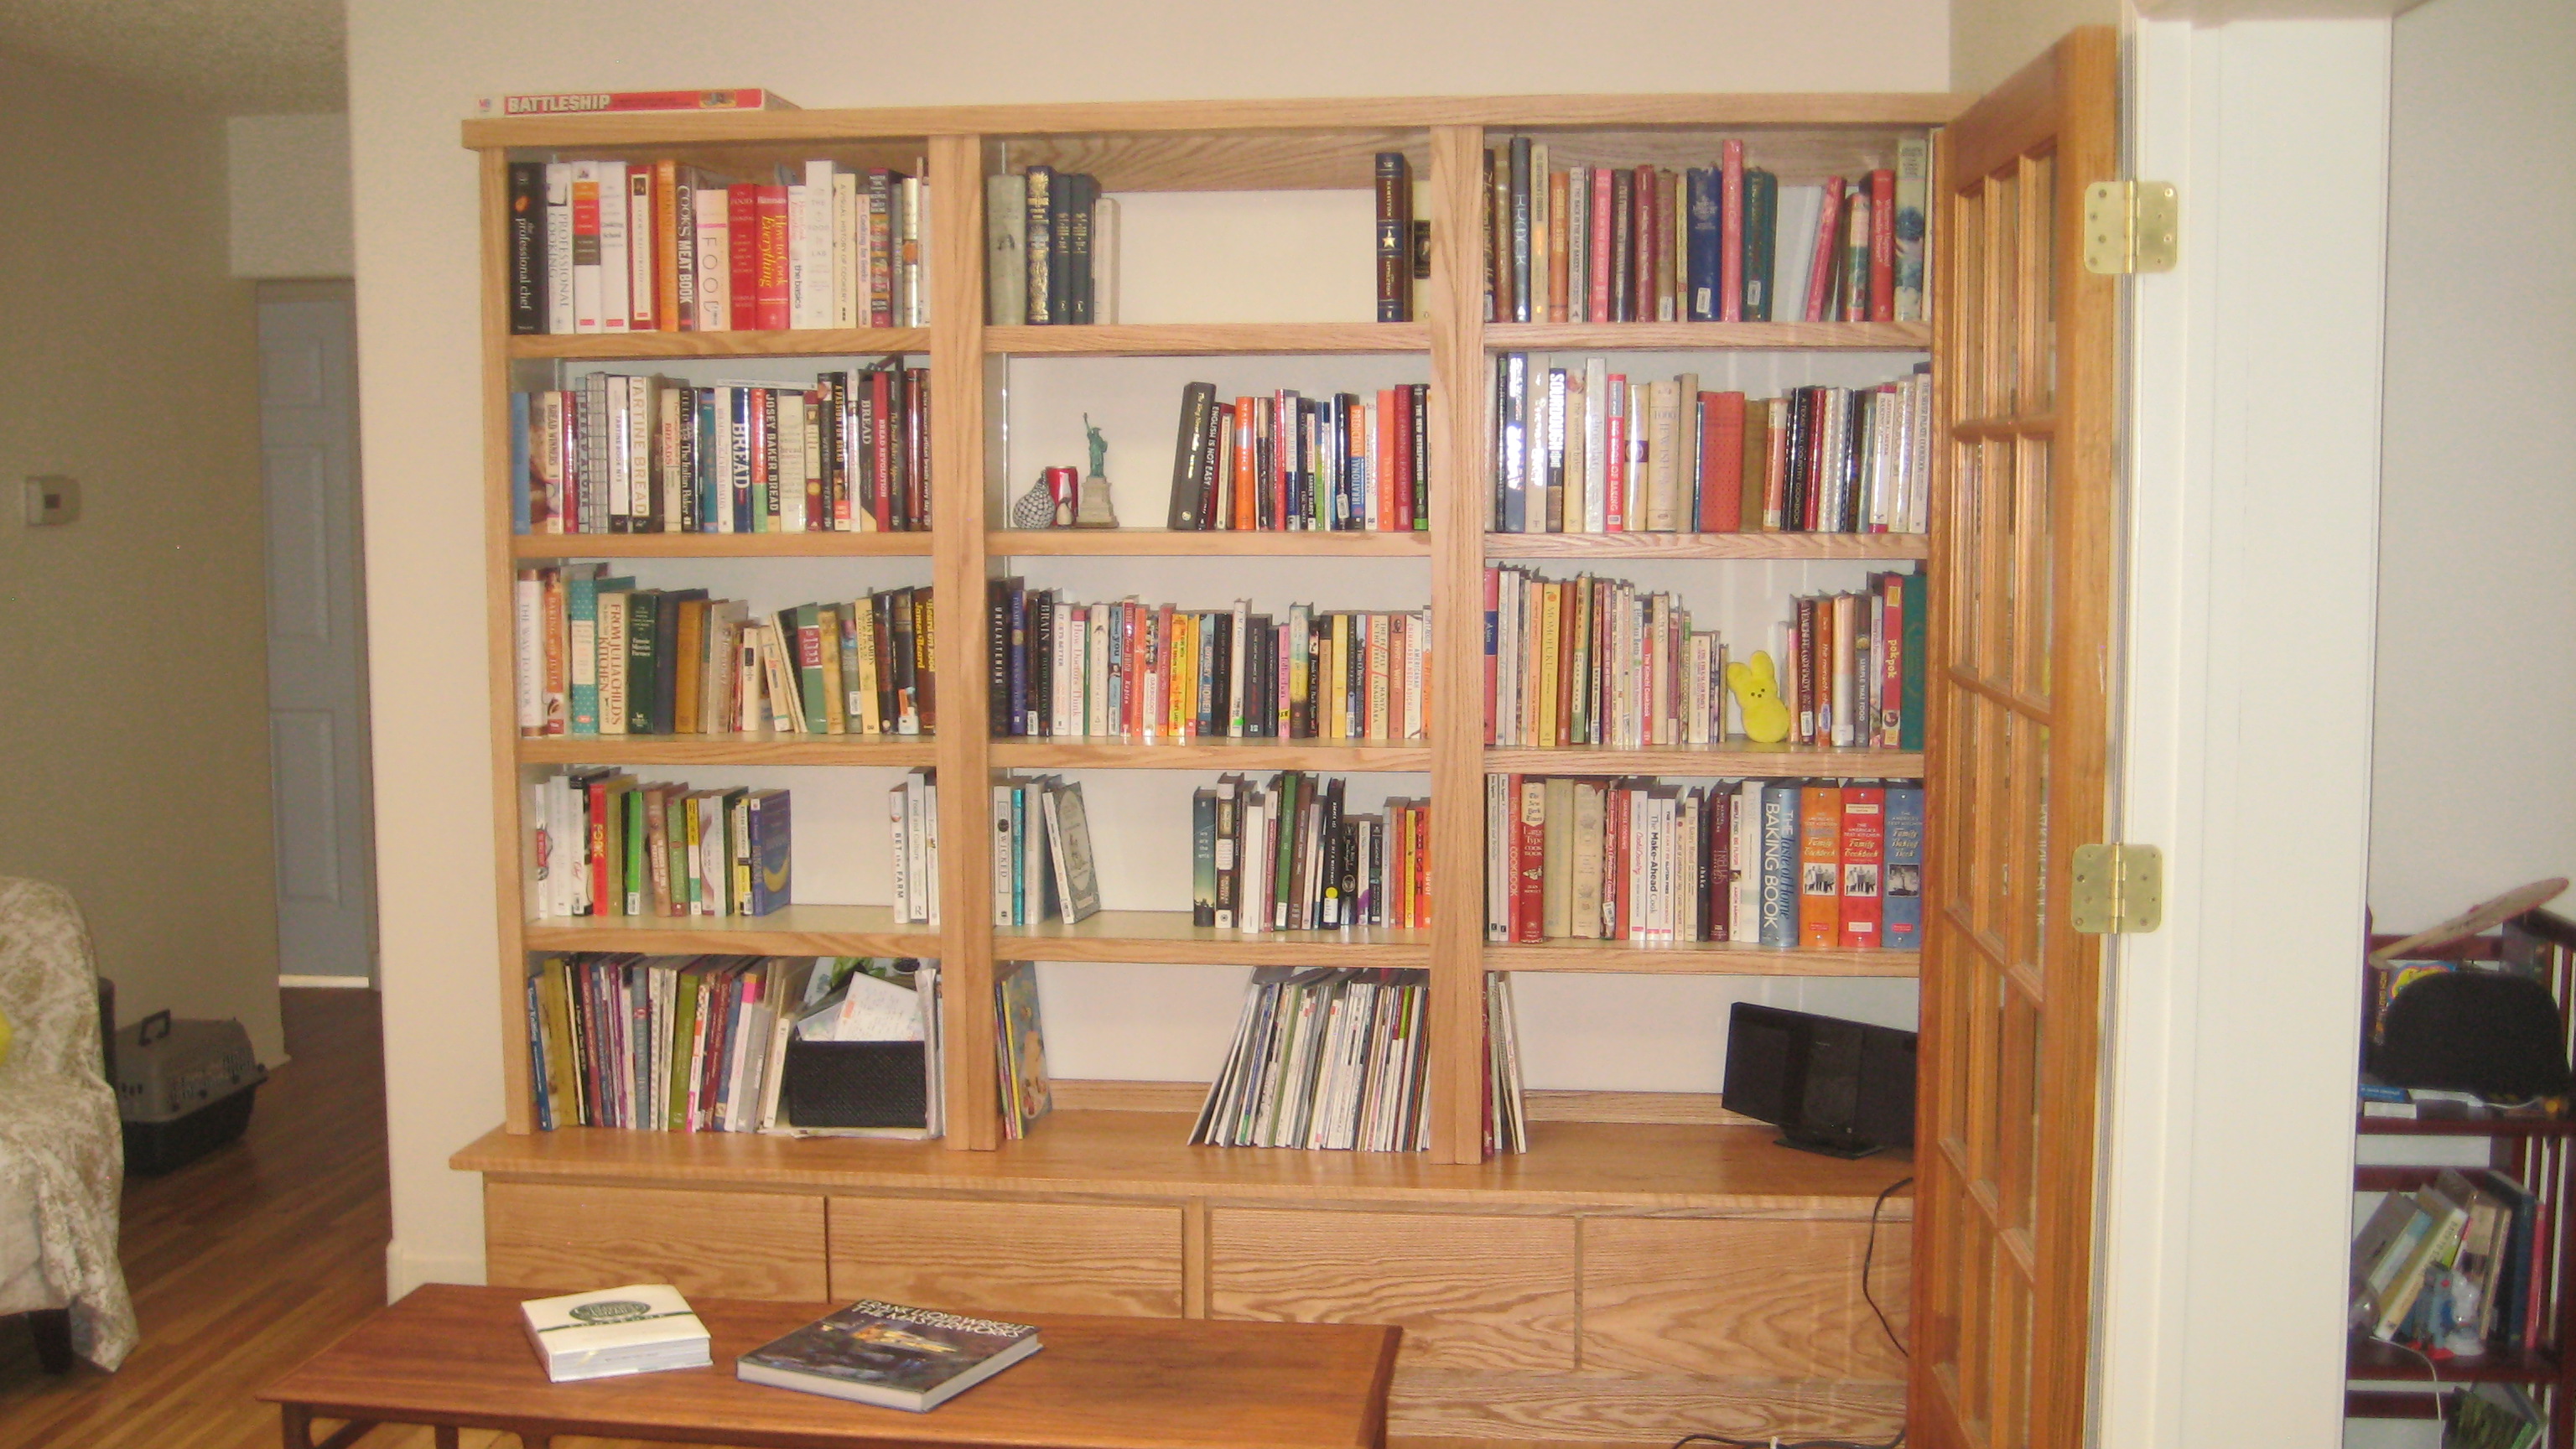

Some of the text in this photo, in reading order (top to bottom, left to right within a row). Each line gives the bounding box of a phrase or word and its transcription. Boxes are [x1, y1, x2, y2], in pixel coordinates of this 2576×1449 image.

[508, 95, 610, 113] BATTLESHIP
[775, 214, 787, 240] How
[515, 218, 531, 310] professional chef
[759, 216, 776, 288] Everything
[776, 256, 788, 286] Cook
[794, 265, 802, 309] the basics
[861, 400, 872, 444] BREAD
[1209, 406, 1220, 438] ENGLISH
[1549, 373, 1565, 450] SOURDOUGH
[632, 377, 647, 514] TARTINE BREAD
[682, 444, 691, 461] The
[732, 423, 750, 489] BREAD
[766, 394, 778, 511] JOSEY BAKER BREAD
[1206, 448, 1216, 465] NOT
[682, 462, 692, 489] Italian
[1203, 465, 1213, 486] EASY
[1352, 459, 1361, 505] IRRATIONAL
[683, 490, 693, 514] Baker
[1610, 480, 1618, 511] BAKING
[610, 604, 621, 639] FROM
[927, 599, 935, 632] Beard
[915, 602, 926, 668] James Beard
[995, 606, 1004, 684] UNFLATTENING
[1485, 623, 1493, 642] Asian
[1545, 606, 1555, 670] MOMOFUKU
[599, 636, 610, 692] KITCHEN
[607, 642, 621, 675] JULIA
[1072, 623, 1083, 717] How Doctors Think
[1203, 647, 1212, 677] ODYSSEY
[1202, 684, 1211, 714] HOMER
[1784, 810, 1794, 835] THE
[1893, 828, 1918, 839] Family
[1805, 848, 1836, 856] Cookbook
[1810, 837, 1833, 847] Family
[1845, 849, 1878, 857] Cookbook
[1850, 839, 1874, 849] Family
[1893, 839, 1919, 849] Baking
[1896, 849, 1914, 857] Book
[1509, 846, 1518, 896] COOKBOOK
[1763, 803, 1780, 929] BAKING BOOK
[1781, 869, 1794, 881] of
[1780, 882, 1794, 920] Home
[852, 1305, 1020, 1338] THE MASTERWORKS
[855, 1299, 1035, 1332] FRANK LLOYD WRIGHT
